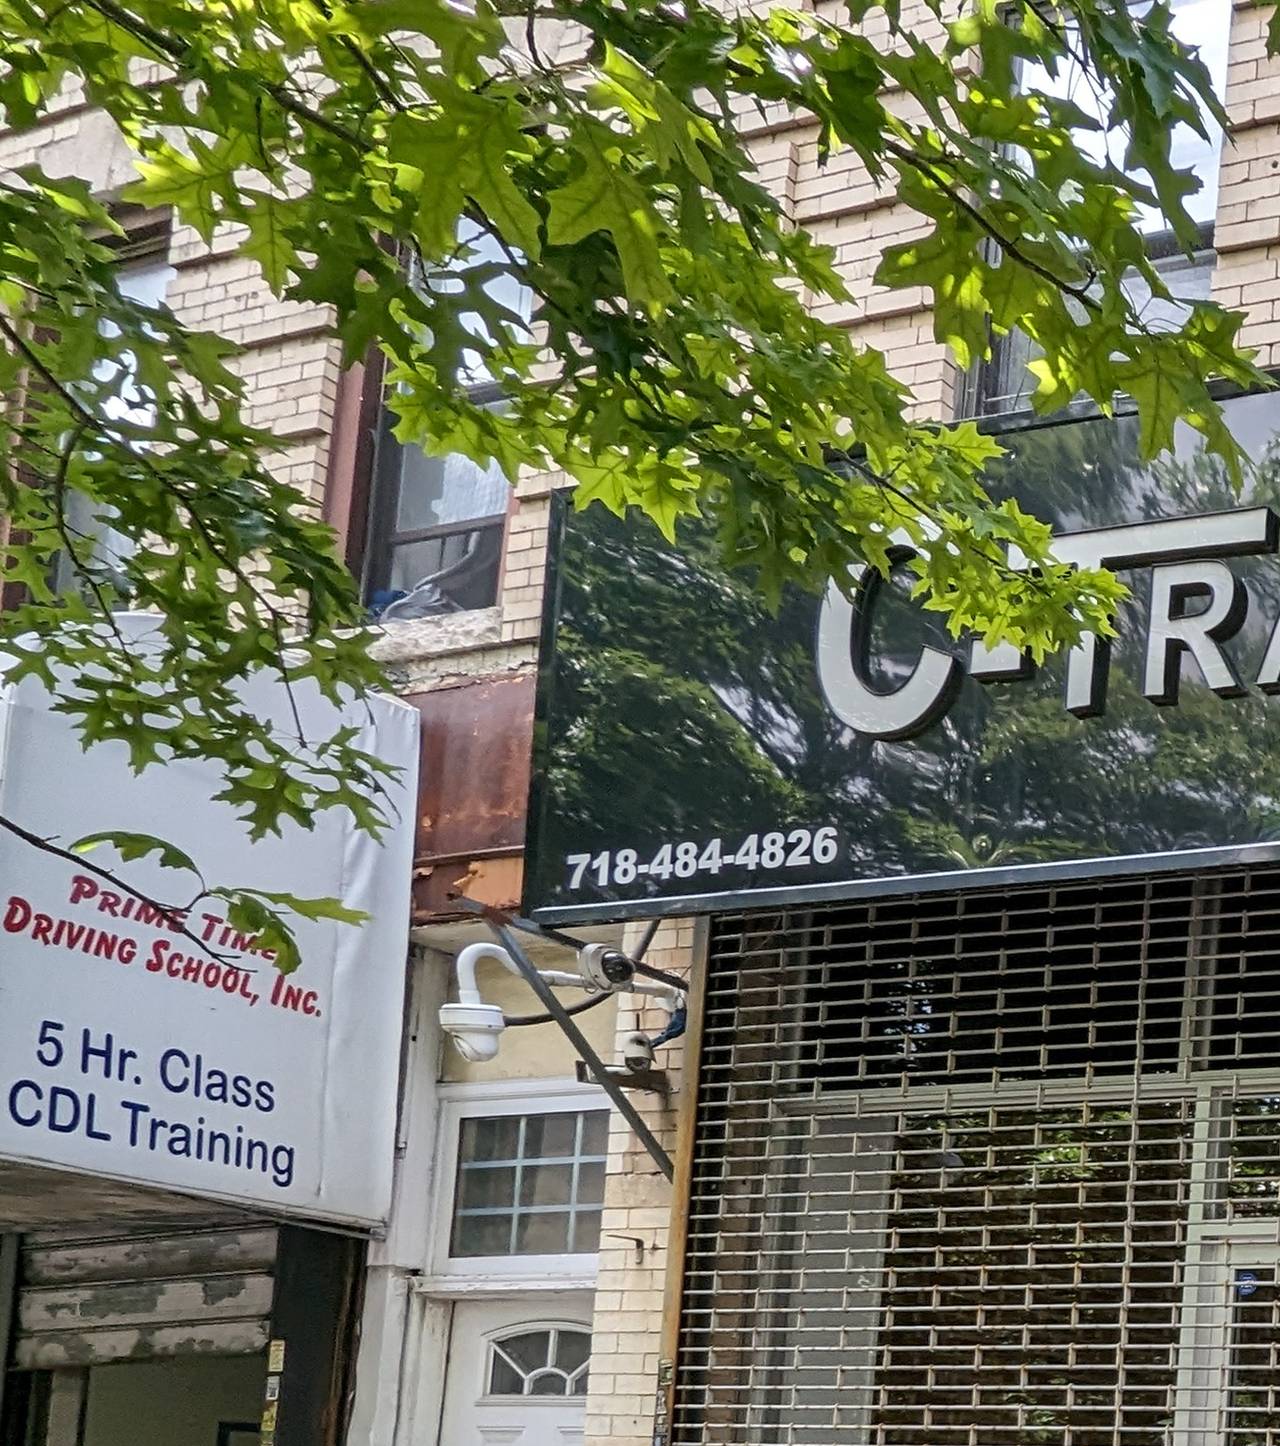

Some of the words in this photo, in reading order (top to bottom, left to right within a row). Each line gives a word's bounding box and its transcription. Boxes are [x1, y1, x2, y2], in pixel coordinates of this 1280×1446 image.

[69, 875, 189, 934] PRIME
[566, 826, 839, 890] 718-484-4826
[2, 896, 138, 965] DRIVING
[146, 939, 260, 1006] SCHOOL,
[36, 1019, 66, 1068] 5
[81, 1028, 142, 1086] Hr.
[160, 1049, 276, 1113] Class
[8, 1080, 112, 1142] CDL
[121, 1100, 297, 1188] Training
